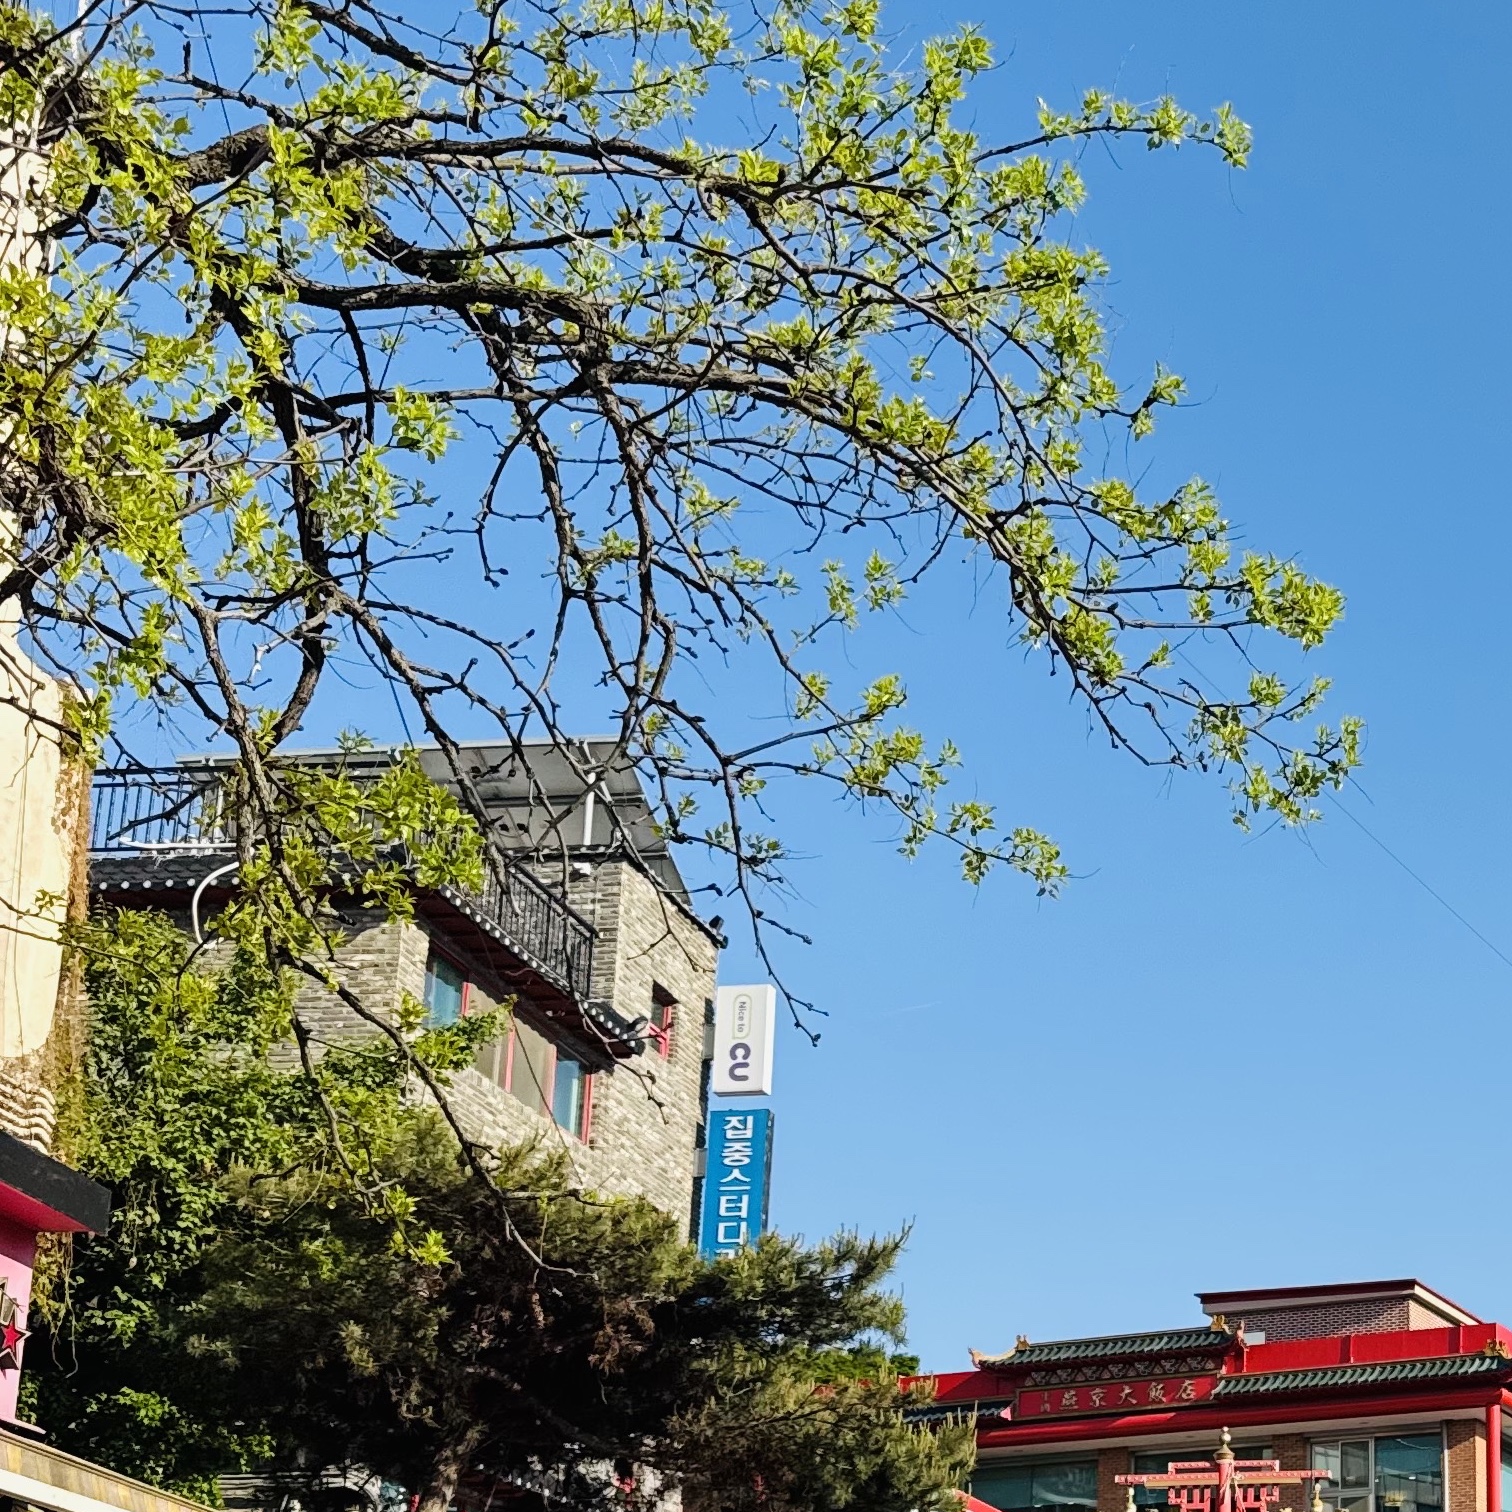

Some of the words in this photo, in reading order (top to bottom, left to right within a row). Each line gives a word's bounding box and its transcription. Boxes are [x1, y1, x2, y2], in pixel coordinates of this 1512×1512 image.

[737, 1001, 746, 1021] Nice
[737, 1023, 745, 1033] to
[729, 1042, 751, 1081] CU
[1059, 1379, 1196, 1410] 燕京大飯店
